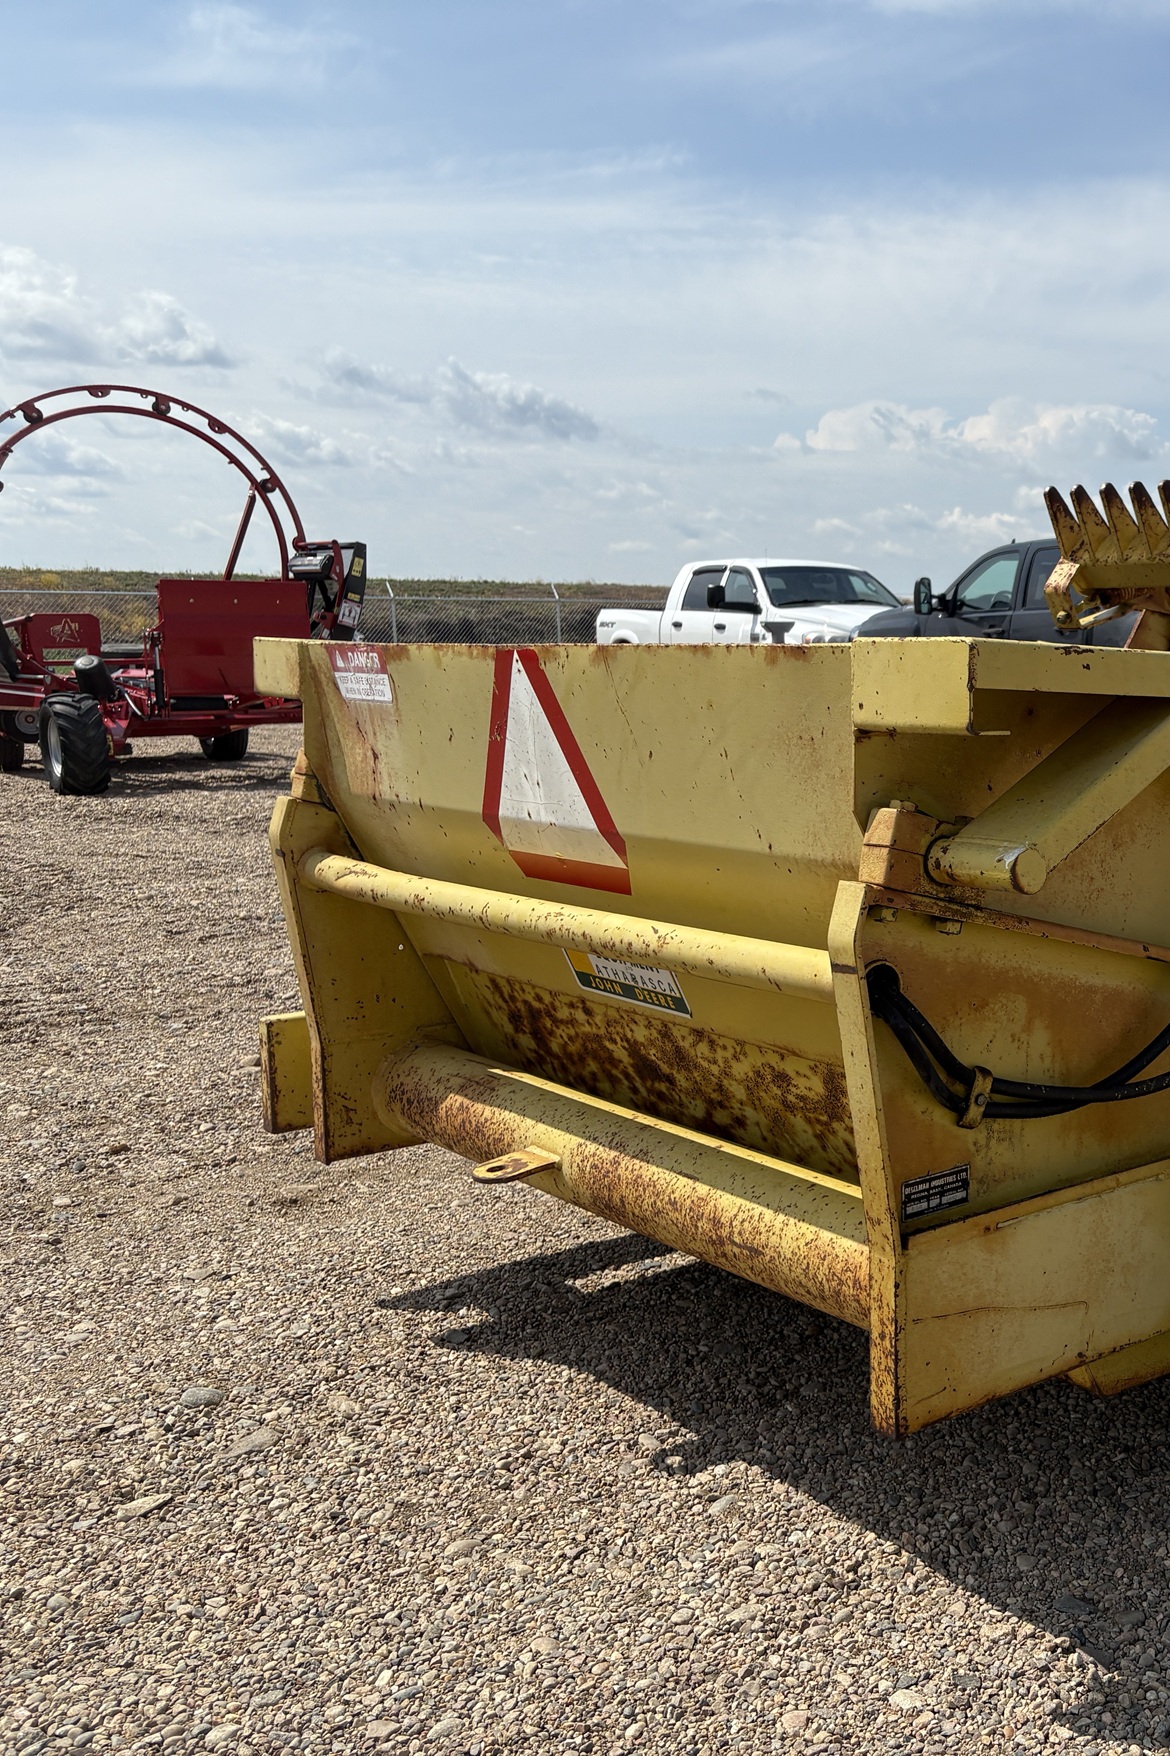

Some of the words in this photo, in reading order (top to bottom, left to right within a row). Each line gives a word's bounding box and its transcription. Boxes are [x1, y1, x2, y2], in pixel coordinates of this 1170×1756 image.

[589, 976, 624, 995] JOHN
[634, 987, 676, 1009] DEERE
[595, 964, 677, 995] ATHABASCA
